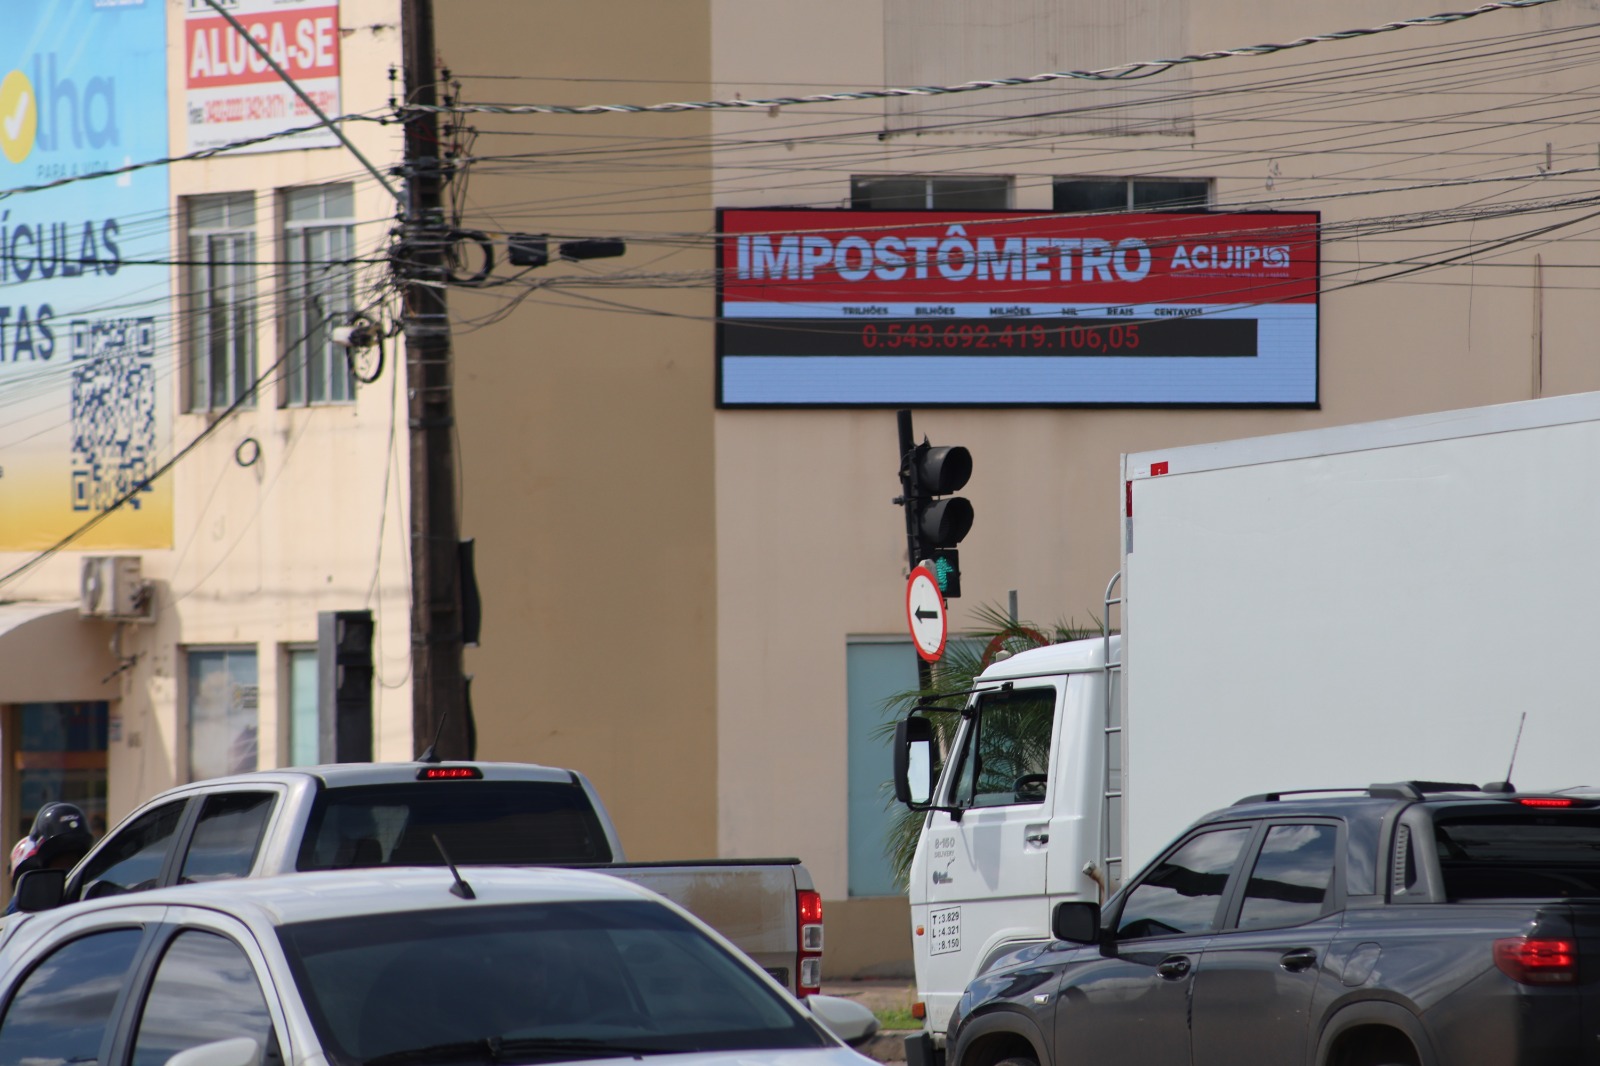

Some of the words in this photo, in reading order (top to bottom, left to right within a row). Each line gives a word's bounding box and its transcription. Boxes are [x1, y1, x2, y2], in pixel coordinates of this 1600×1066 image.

[1, 209, 121, 282] ÍCULAS
[736, 224, 1151, 283] IMPOSTÔMETRO
[1170, 245, 1261, 269] ACIJIP
[842, 306, 889, 316] TRILHÕES
[915, 306, 956, 316] BILHÕES
[989, 306, 1031, 316] MILHÕES
[1061, 308, 1079, 316] MIL
[1107, 308, 1135, 316] REAIS
[1154, 308, 1202, 317] CENTAVOS
[862, 324, 1140, 353] 0.543.692.419.106,05
